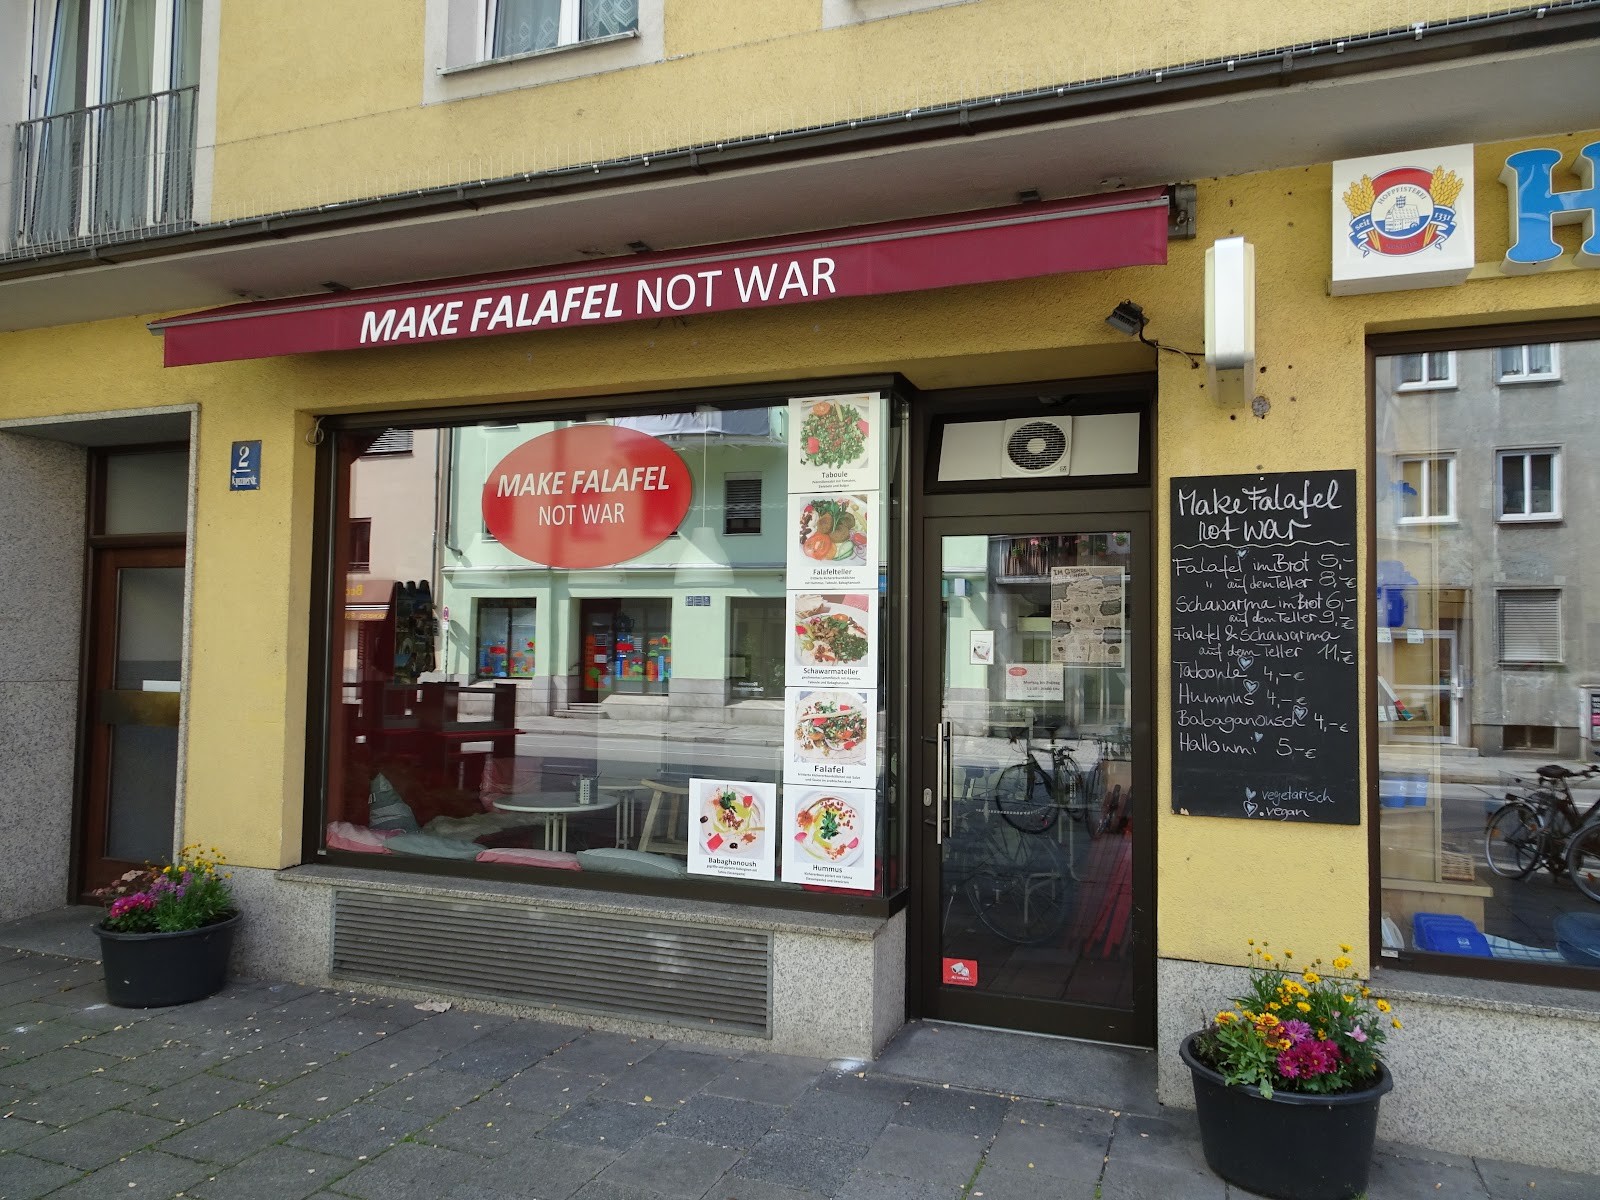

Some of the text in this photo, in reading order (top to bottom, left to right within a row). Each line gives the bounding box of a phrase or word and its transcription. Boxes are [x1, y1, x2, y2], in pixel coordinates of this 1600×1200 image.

[1354, 211, 1451, 231] seit 1331
[359, 256, 837, 344] MAKE FALAFEL NOT WAR
[238, 446, 250, 467] 2
[497, 465, 670, 498] MAKE FALAFEL
[821, 471, 848, 479] Taboule
[1177, 479, 1342, 519] Make Falafel
[539, 502, 625, 526] NOT WAR
[1198, 516, 1312, 542] not war
[1172, 554, 1243, 580] Falafel
[1226, 574, 1248, 595] auf
[1267, 574, 1313, 589] Teller
[1175, 595, 1276, 613] Schawarma
[1274, 610, 1318, 623] Teller
[1255, 643, 1303, 658] Teller
[803, 667, 859, 675] Schawarmateller
[1179, 682, 1255, 706] Hummus
[1179, 732, 1257, 755] Halloumi
[814, 765, 844, 773] Falafel
[1261, 786, 1335, 806] vegetarisch
[708, 857, 757, 867] Babaghanoush
[813, 864, 843, 873] Hummus
